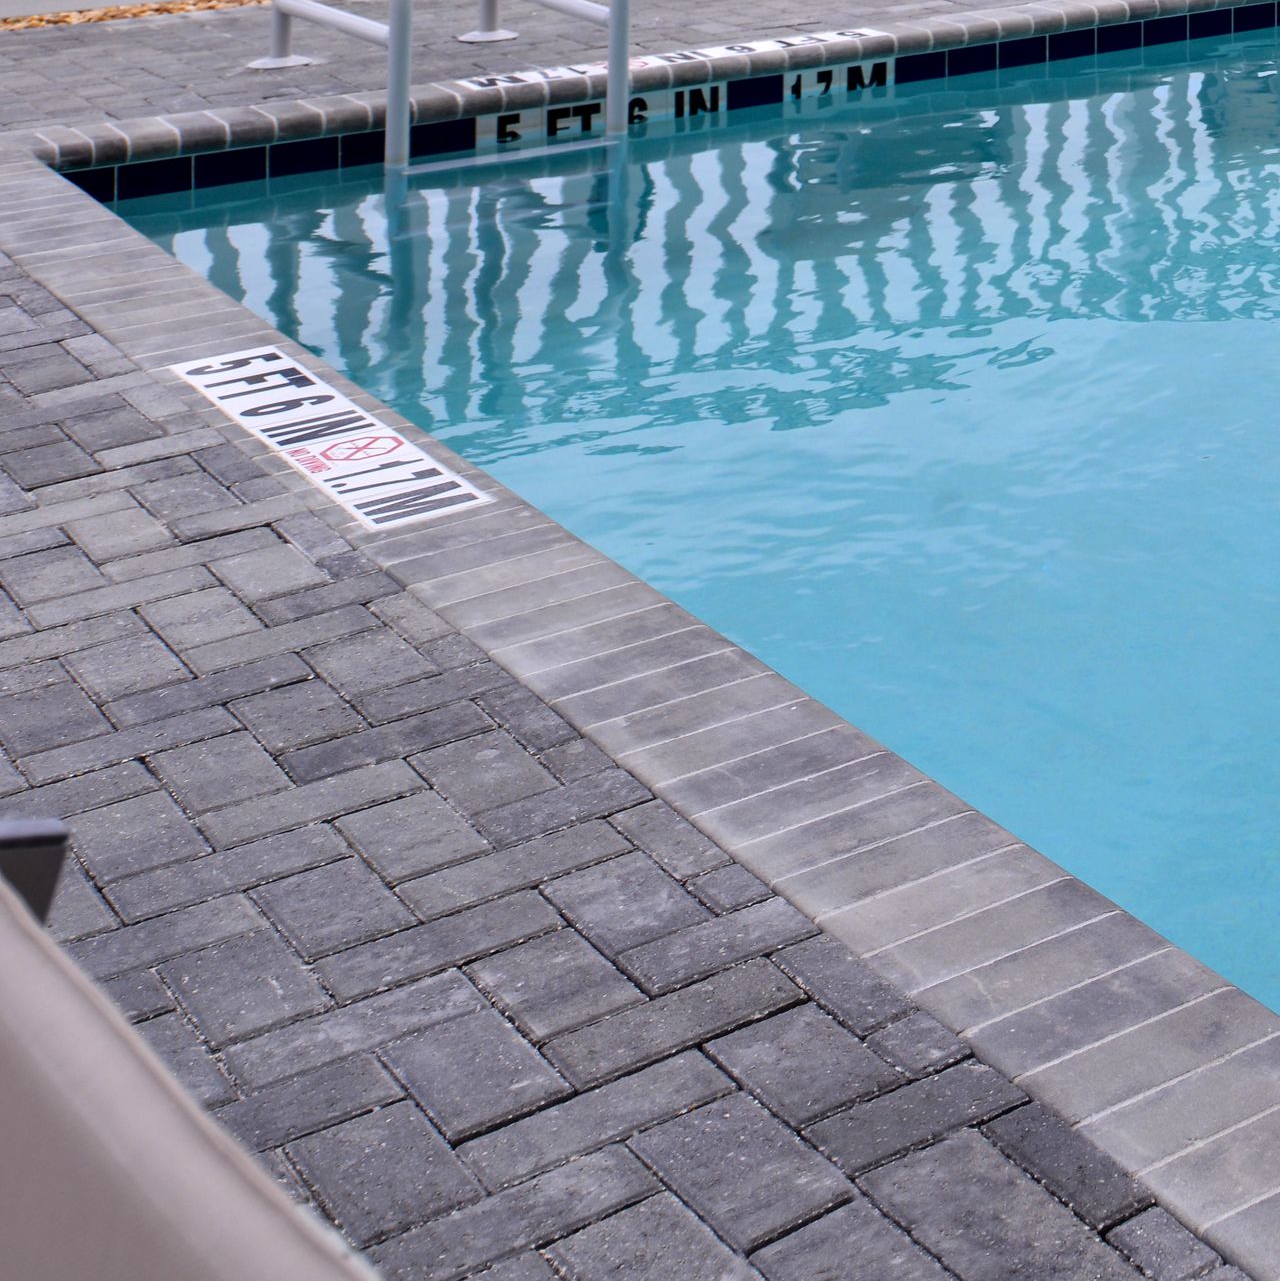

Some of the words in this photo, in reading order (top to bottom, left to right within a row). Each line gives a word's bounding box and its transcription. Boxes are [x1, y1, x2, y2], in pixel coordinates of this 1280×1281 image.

[775, 36, 828, 49] FT
[836, 31, 868, 40] 5
[655, 50, 710, 63] IN
[497, 113, 521, 144] 5
[546, 103, 601, 137] FT
[628, 97, 648, 125] 6
[674, 85, 719, 118] IN
[847, 62, 887, 91] M
[186, 352, 284, 376] 5
[204, 367, 317, 400] FT
[239, 394, 336, 417] 6
[260, 409, 377, 446] IN
[286, 447, 311, 457] NO
[295, 454, 332, 474] DIVING
